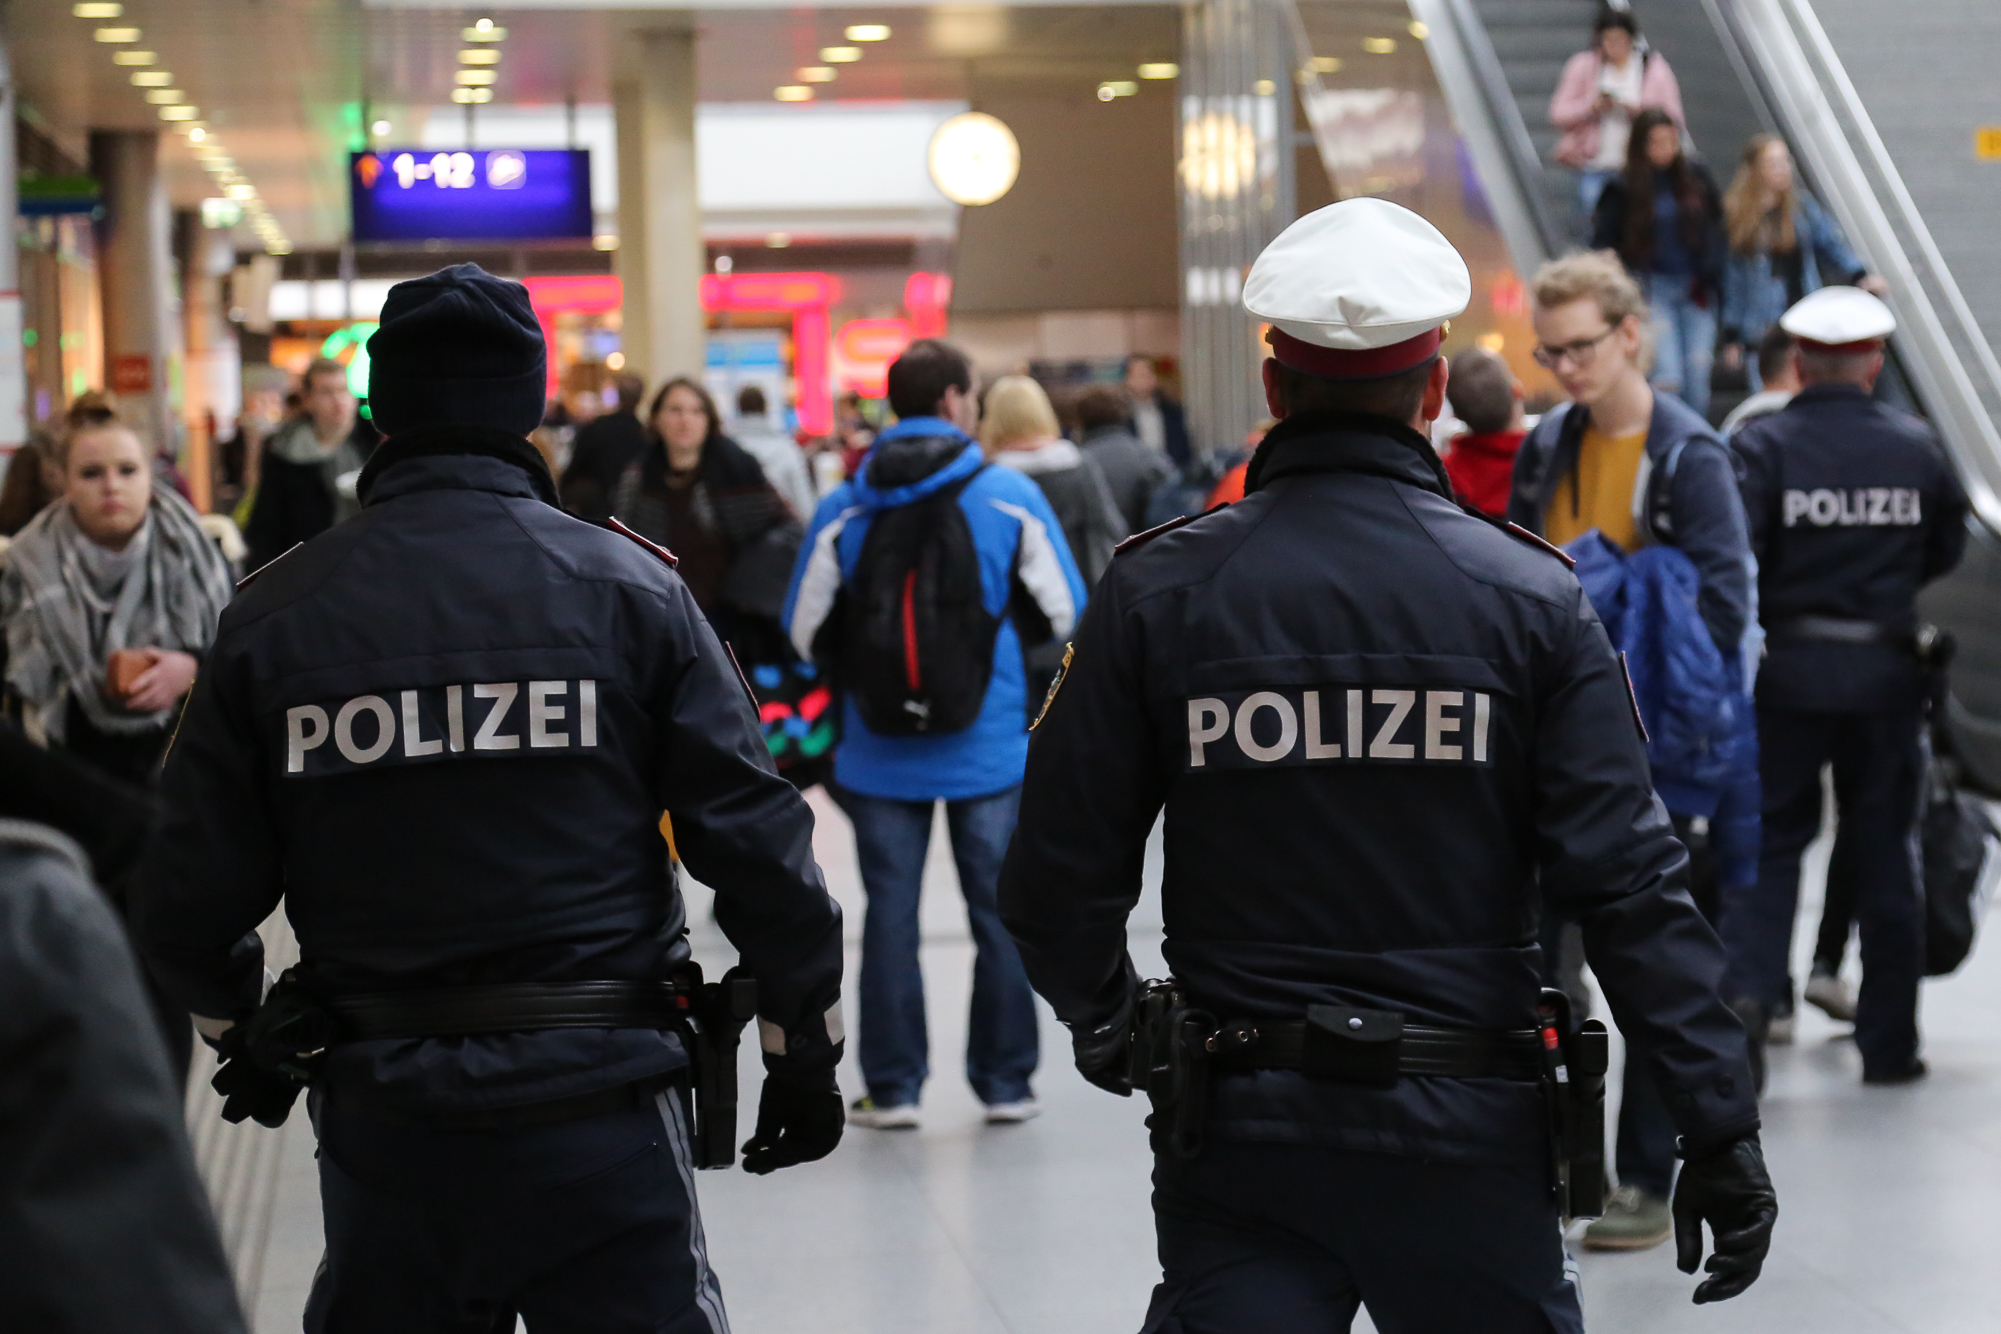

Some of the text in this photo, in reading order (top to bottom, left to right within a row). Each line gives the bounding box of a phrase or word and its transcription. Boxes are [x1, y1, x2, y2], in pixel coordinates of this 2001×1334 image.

[392, 152, 476, 189] 1-12
[1783, 487, 1922, 527] POLIZEI
[286, 680, 598, 773] POLIZEI
[1188, 690, 1490, 767] POLIZEI
